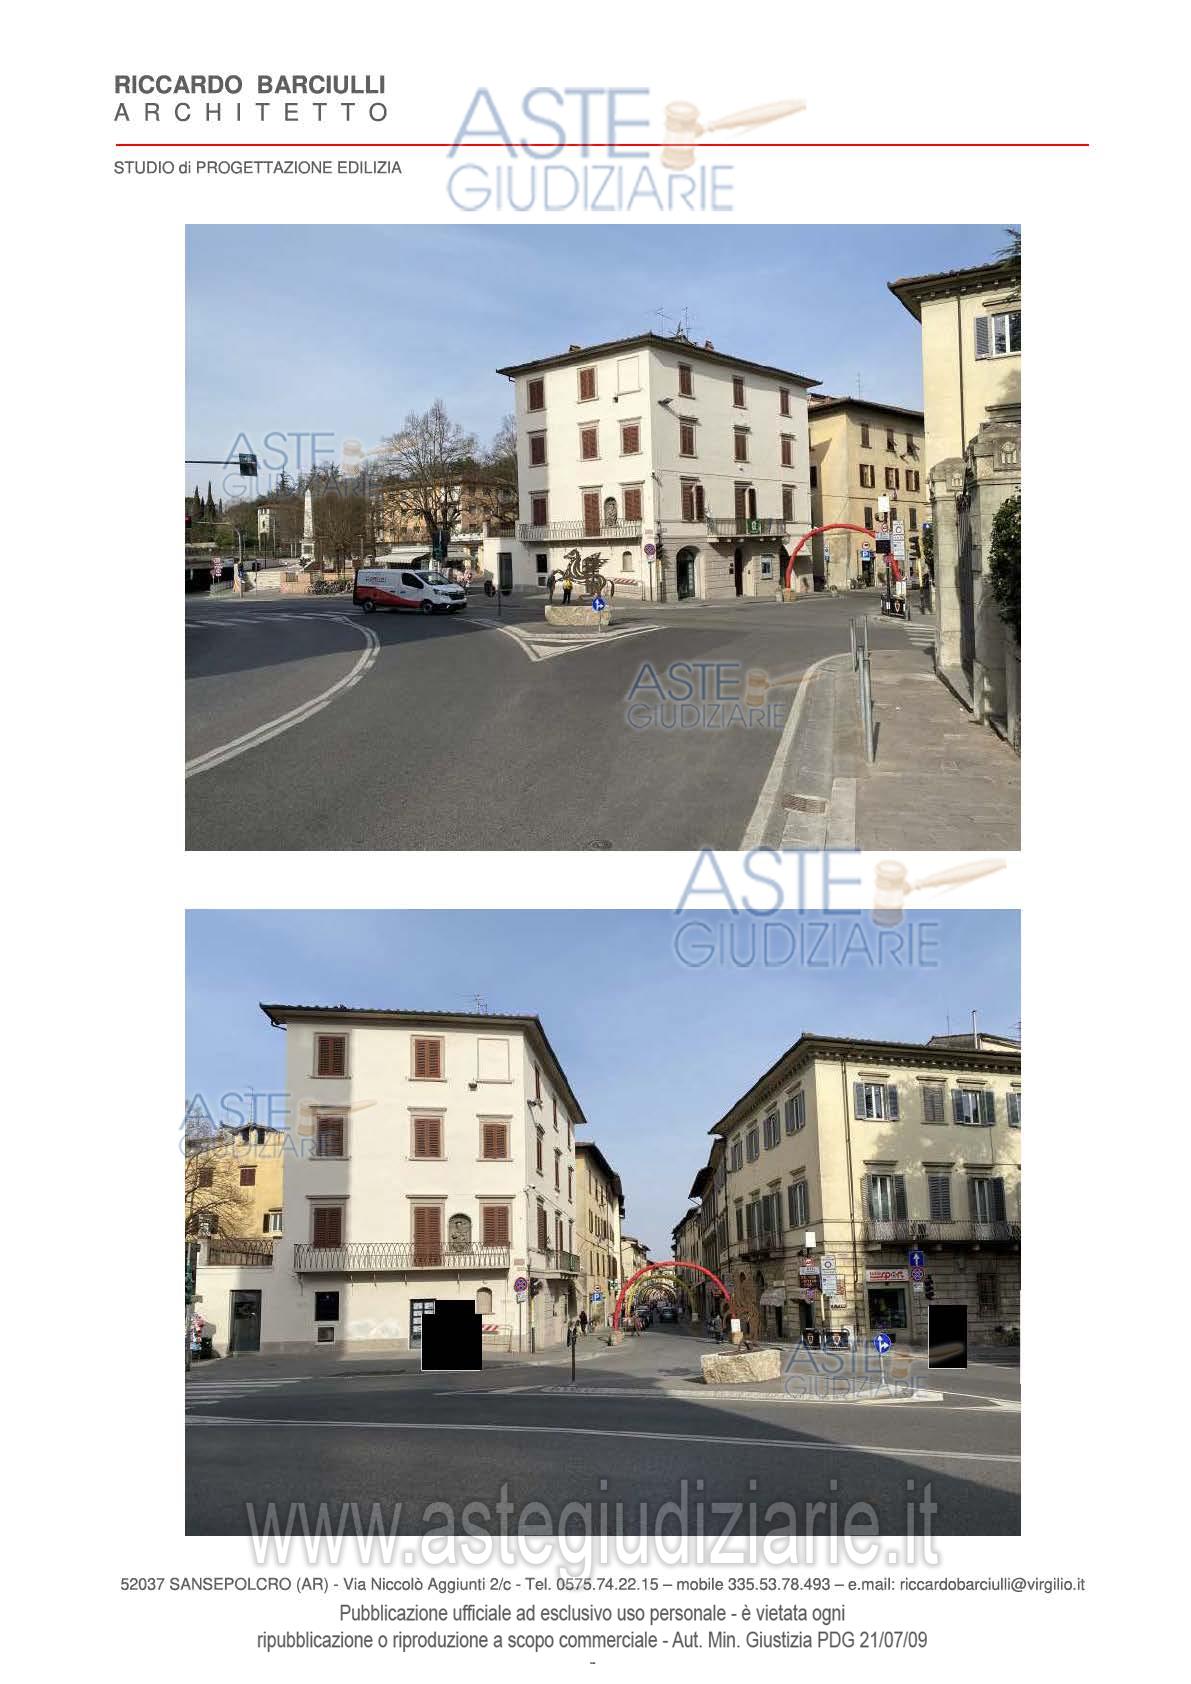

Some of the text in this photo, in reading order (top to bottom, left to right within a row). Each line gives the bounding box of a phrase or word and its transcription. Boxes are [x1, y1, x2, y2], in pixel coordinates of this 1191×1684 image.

[115, 75, 384, 94] RICCARDO BARCIULLI
[114, 161, 402, 174] STUDIO di PROGETTAZIONE EDILIZIA
[121, 1578, 165, 1590] 52037
[170, 1577, 291, 1590] SANSEPOLCRO
[297, 1577, 328, 1593] (AR)
[344, 1578, 366, 1590] Via
[372, 1577, 423, 1590] Niccolò
[428, 1578, 485, 1593] Aggiunti
[490, 1578, 511, 1590] 2/c
[525, 1577, 551, 1590] Tel.
[557, 1578, 658, 1590] 0575.74.22.15
[677, 1577, 723, 1590] mobile
[728, 1578, 830, 1590] 335.53.78.493
[848, 1577, 894, 1591] e.mail:
[901, 1577, 1085, 1593] riccardobarciulli@virgilio.it
